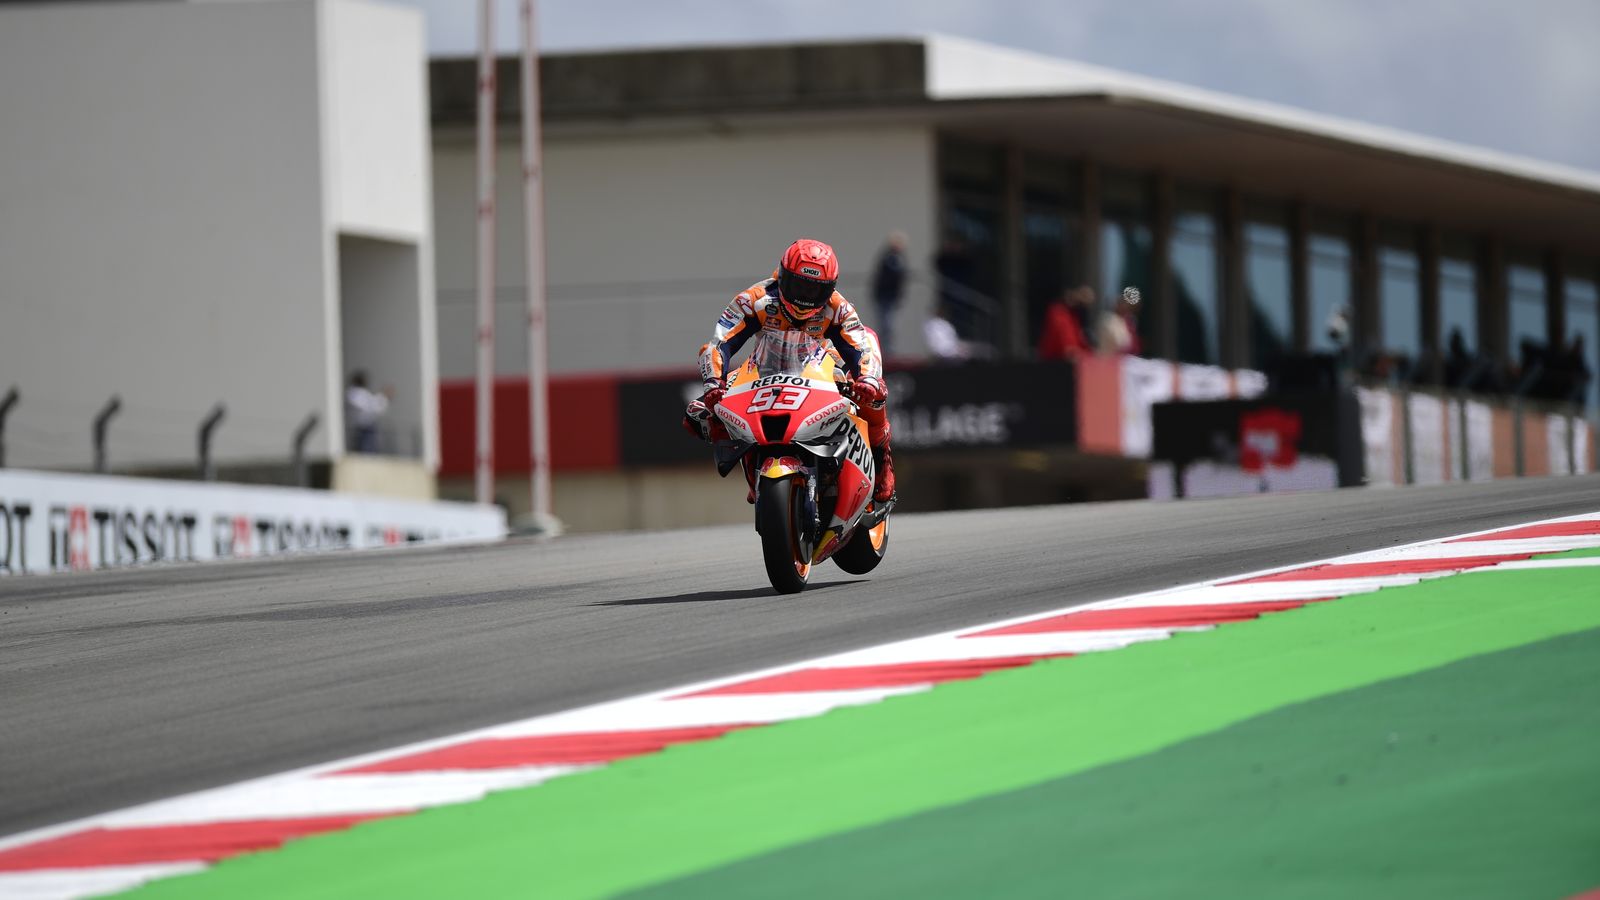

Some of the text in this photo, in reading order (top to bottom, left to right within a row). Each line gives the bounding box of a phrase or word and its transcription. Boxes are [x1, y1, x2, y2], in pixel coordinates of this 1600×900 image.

[803, 267, 820, 276] SHOEI
[751, 374, 811, 389] REPSOL
[746, 385, 811, 415] 93
[717, 407, 747, 430] HONDA
[805, 402, 846, 427] HONDA
[93, 508, 196, 567] TISSOT
